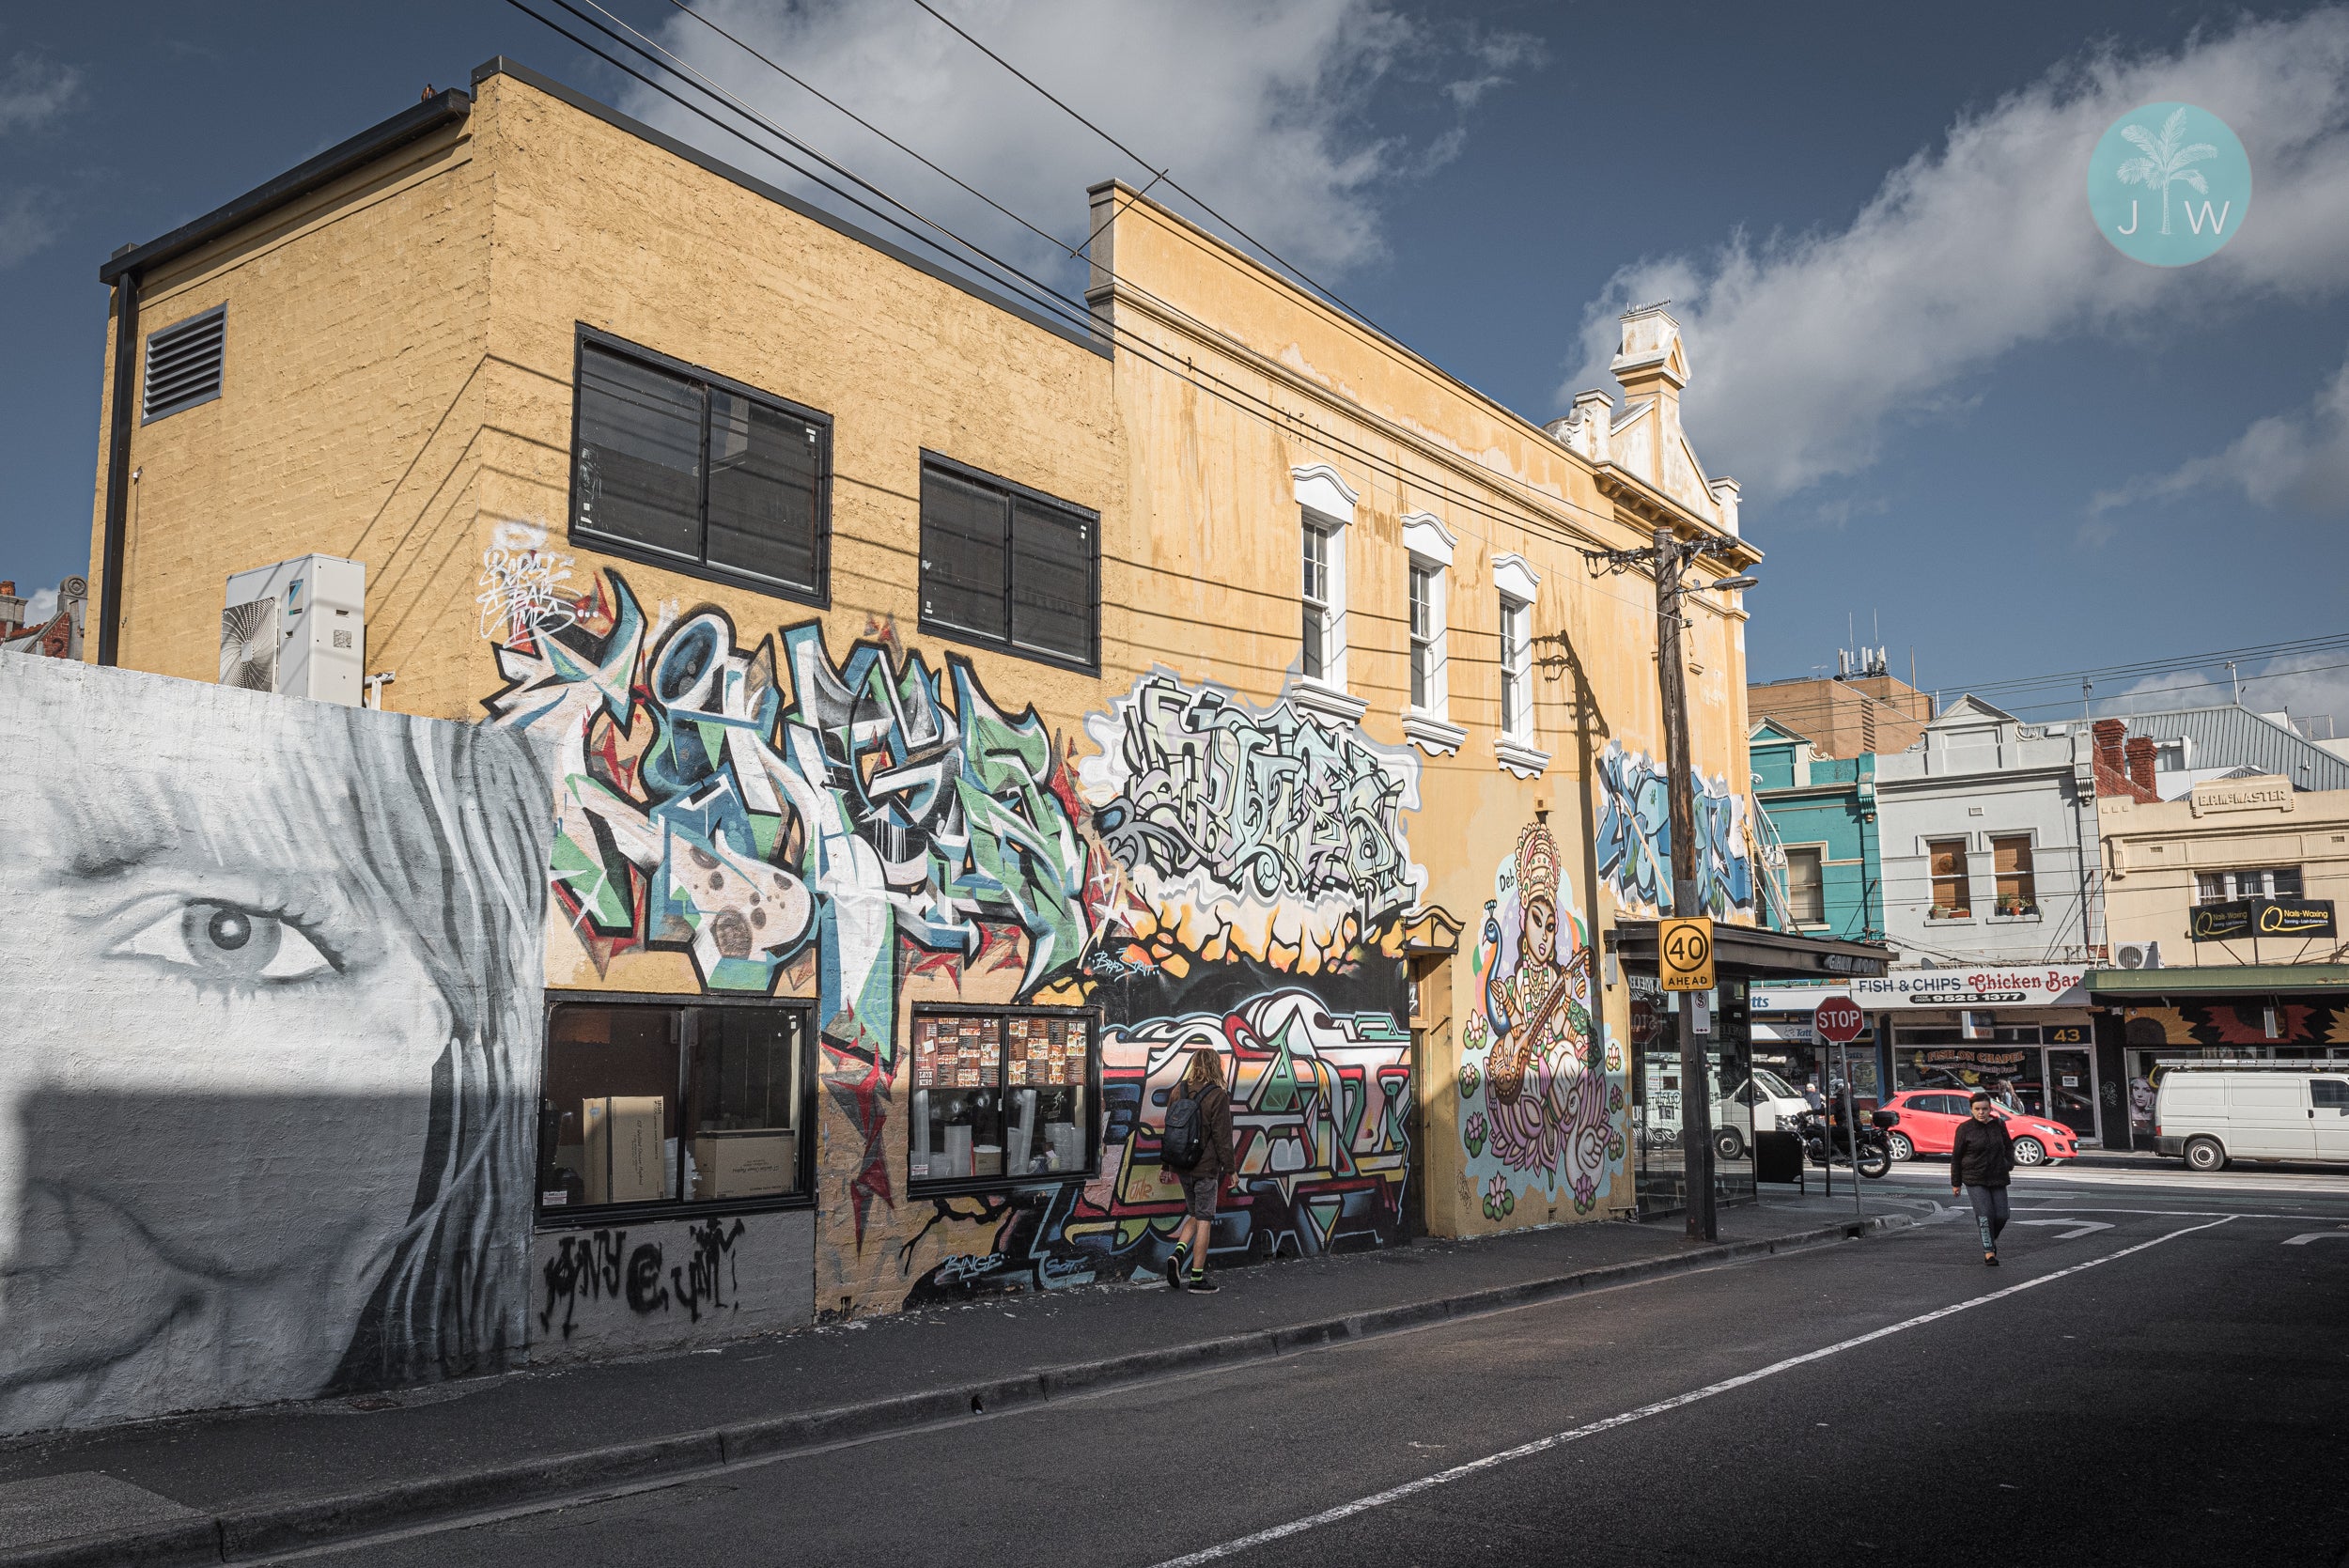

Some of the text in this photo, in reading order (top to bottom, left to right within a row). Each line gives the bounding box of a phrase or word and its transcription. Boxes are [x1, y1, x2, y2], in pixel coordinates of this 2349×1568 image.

[1500, 868, 1516, 893] Deb
[1669, 937, 1704, 960] 40
[1668, 976, 1707, 986] AHEAD
[1859, 971, 2080, 993] FISH & CHIPS Chicken Bar
[1932, 994, 1978, 1002] 9525
[1818, 1010, 1860, 1029] STOP
[2053, 1029, 2081, 1042] 43
[1927, 1050, 2025, 1064] FISH ON CHAPEL
